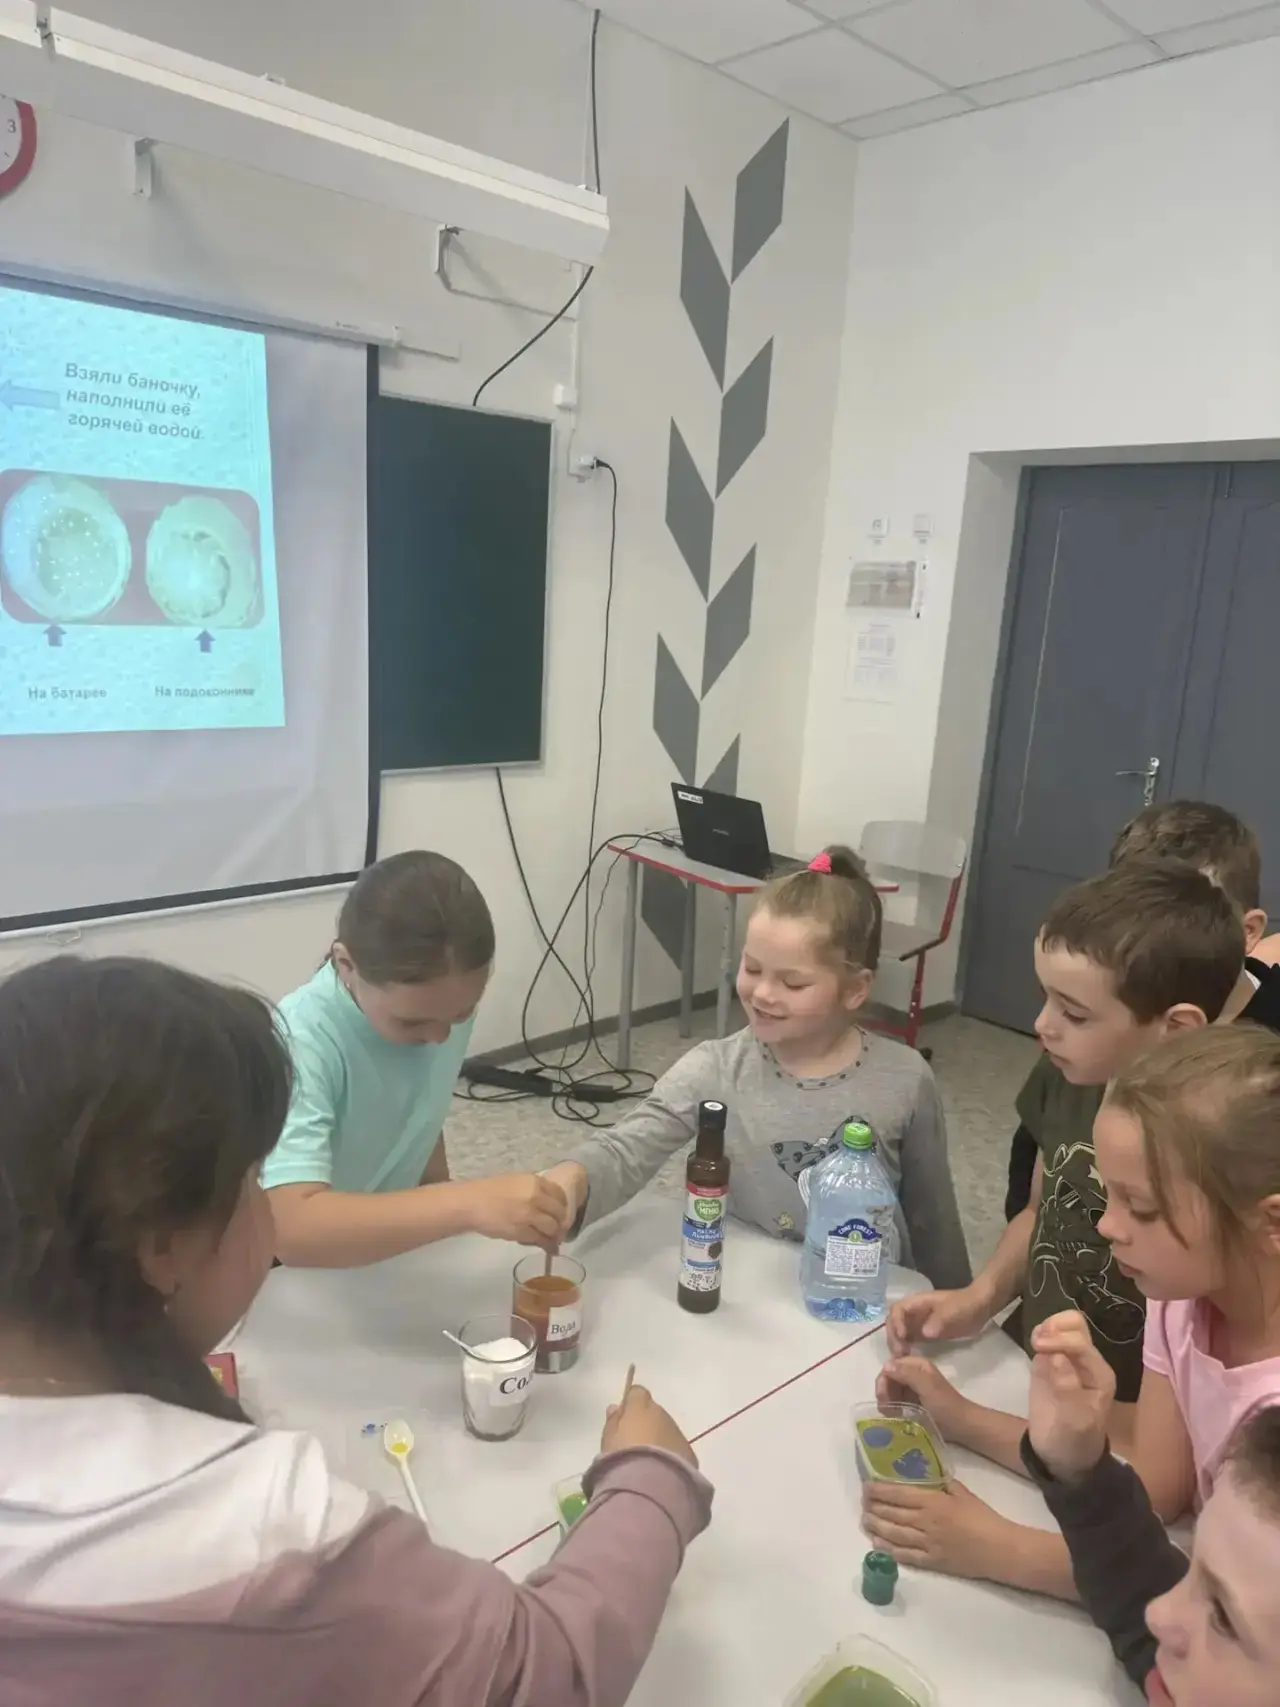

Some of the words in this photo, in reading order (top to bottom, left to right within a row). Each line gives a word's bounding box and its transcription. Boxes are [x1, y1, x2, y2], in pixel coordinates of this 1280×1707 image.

[7, 119, 17, 134] 3
[64, 362, 122, 384] Взяли
[128, 372, 201, 400] баночку,
[66, 389, 166, 414] наполнили
[171, 402, 191, 417] её
[68, 413, 143, 434] горячей
[28, 686, 46, 700] На
[51, 686, 107, 700] батарее
[155, 685, 172, 698] На
